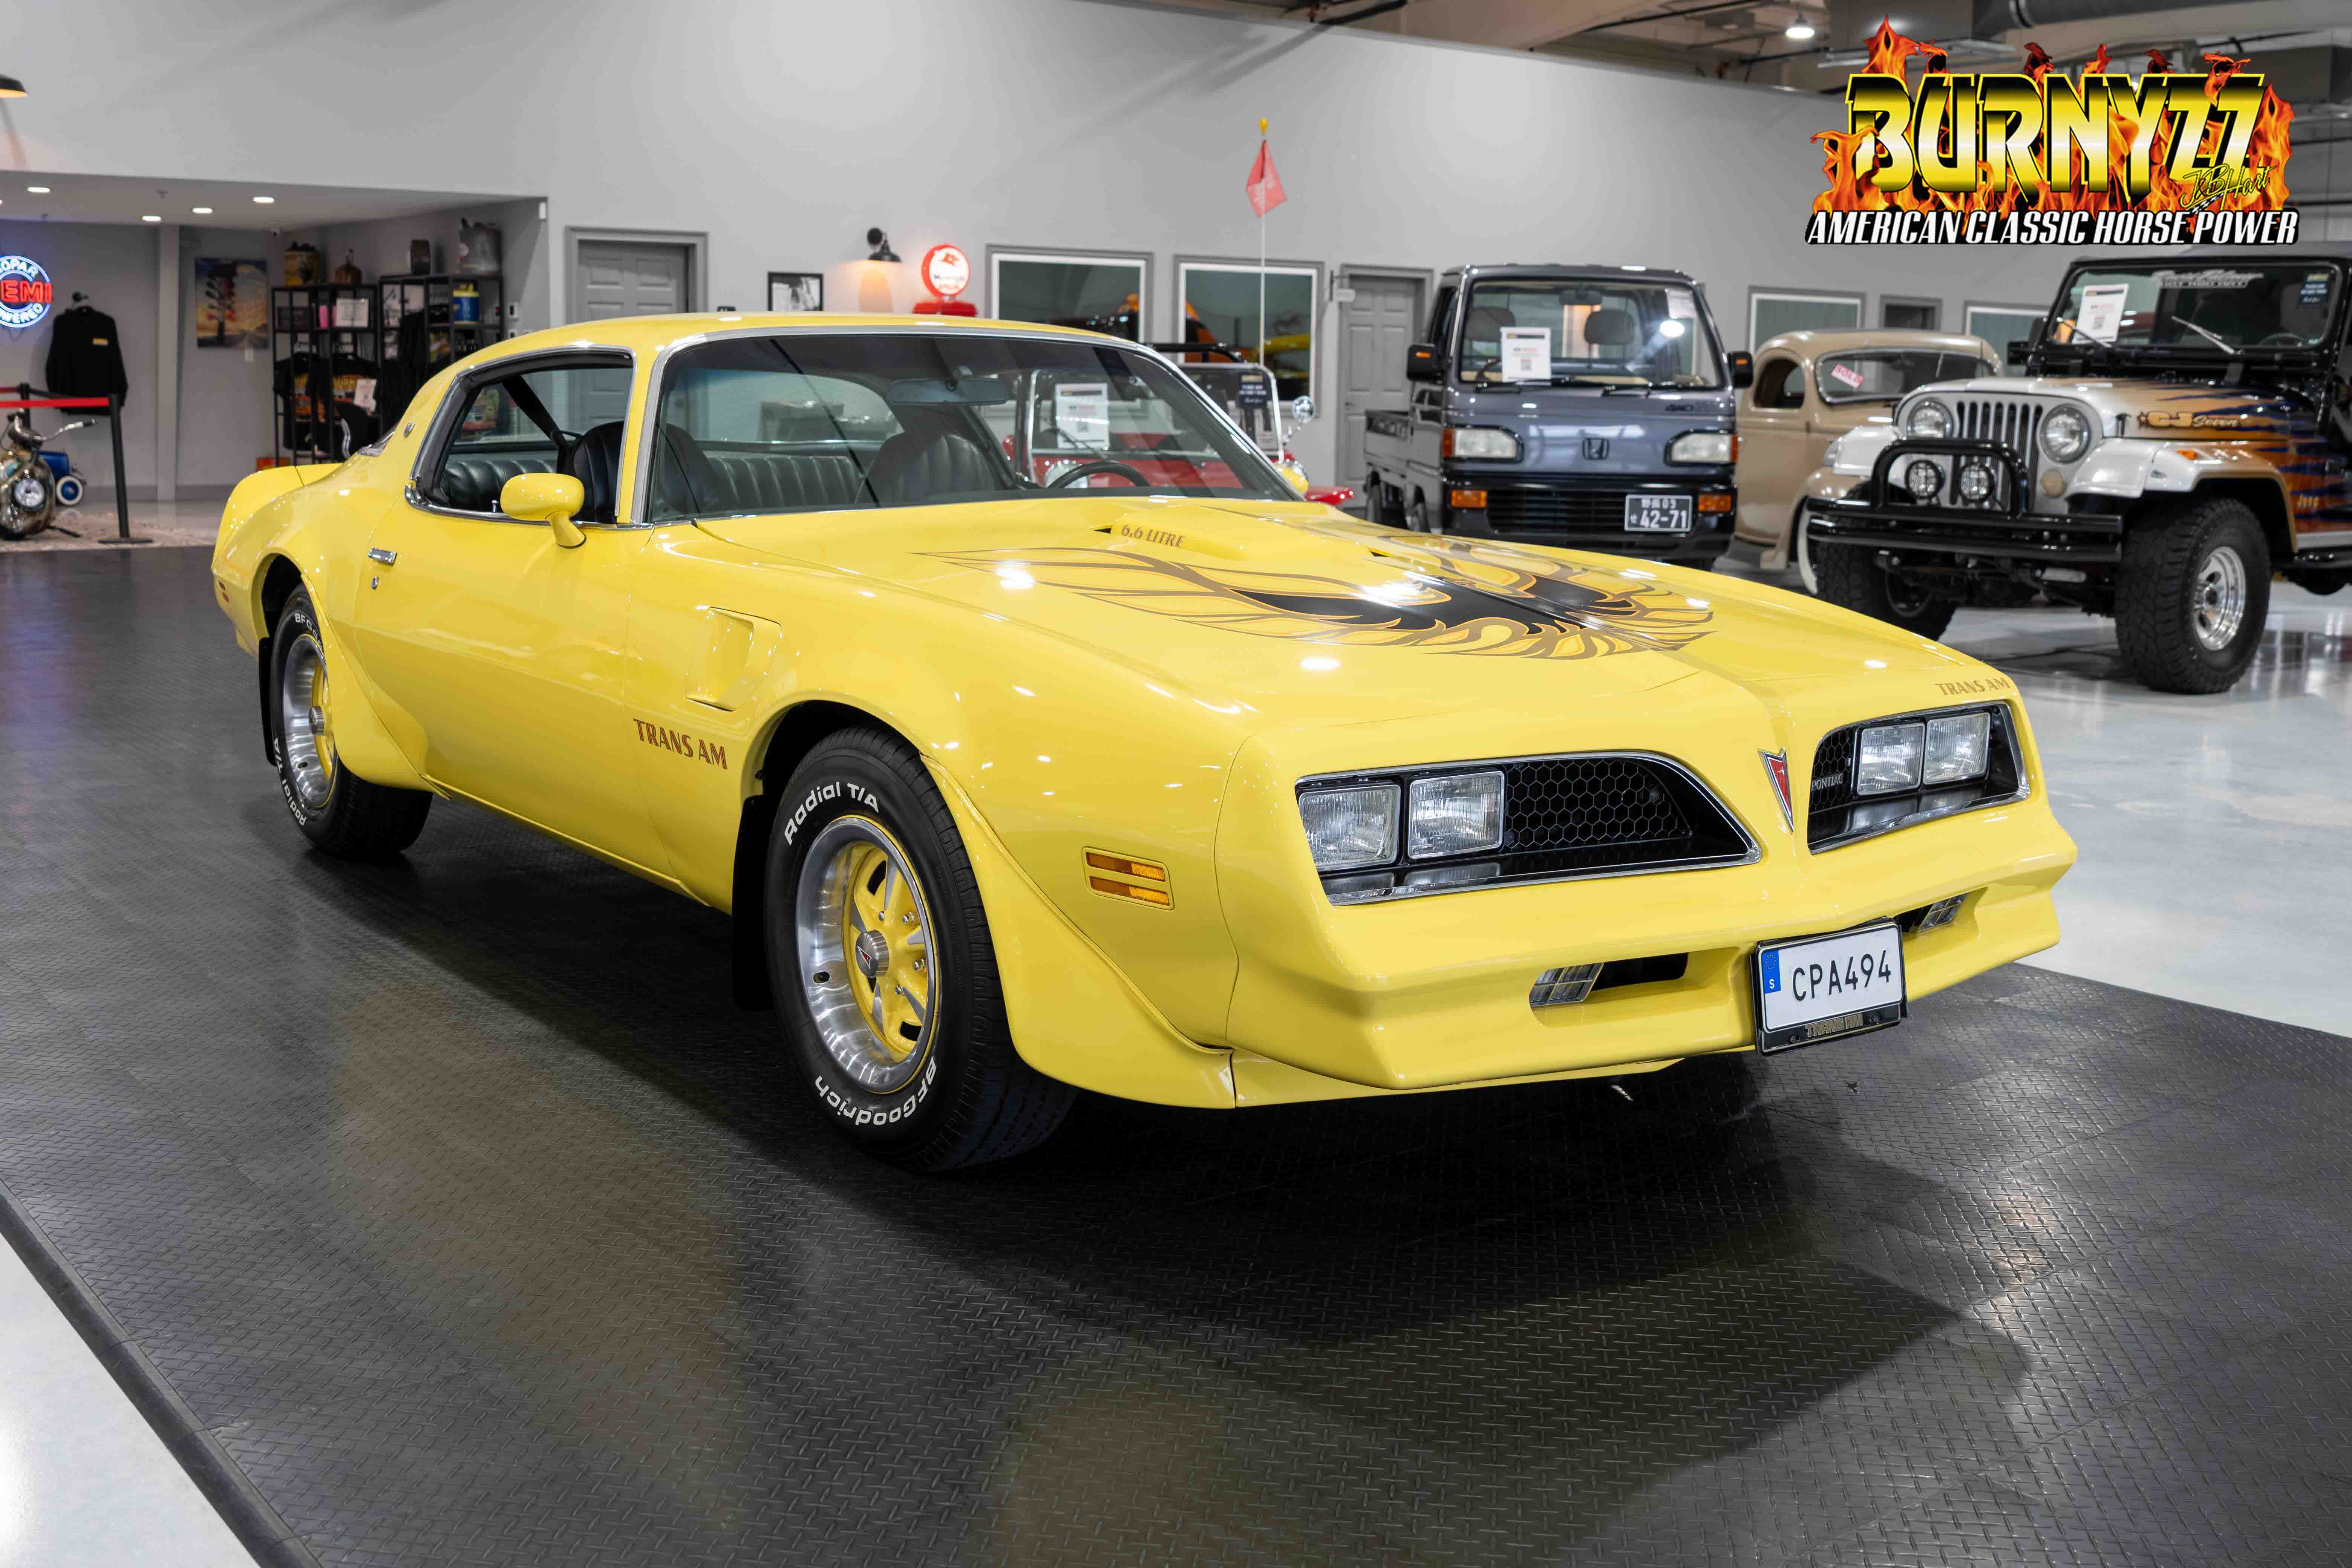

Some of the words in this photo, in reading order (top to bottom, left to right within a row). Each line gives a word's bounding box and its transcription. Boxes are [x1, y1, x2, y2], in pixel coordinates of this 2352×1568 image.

[0, 280, 52, 303] EMI
[0, 303, 43, 323] WERED
[1640, 509, 1687, 528] 42-71
[1121, 524, 1143, 539] 6.6
[1146, 529, 1185, 548] LITRE
[1934, 680, 1986, 695] TRANS
[1985, 677, 2011, 691] AM
[633, 718, 694, 758] TRANS
[699, 739, 727, 770] AM
[1811, 774, 1843, 791] PONTIAC
[282, 779, 306, 826] Radial
[784, 781, 841, 846] Radial
[847, 782, 879, 813] T/A
[1769, 978, 1775, 989] S
[1792, 949, 1891, 1001] CPA494
[1805, 1017, 1844, 1038] TRANS
[1845, 1013, 1864, 1029] AM
[815, 1056, 937, 1125] BFGoodrich
